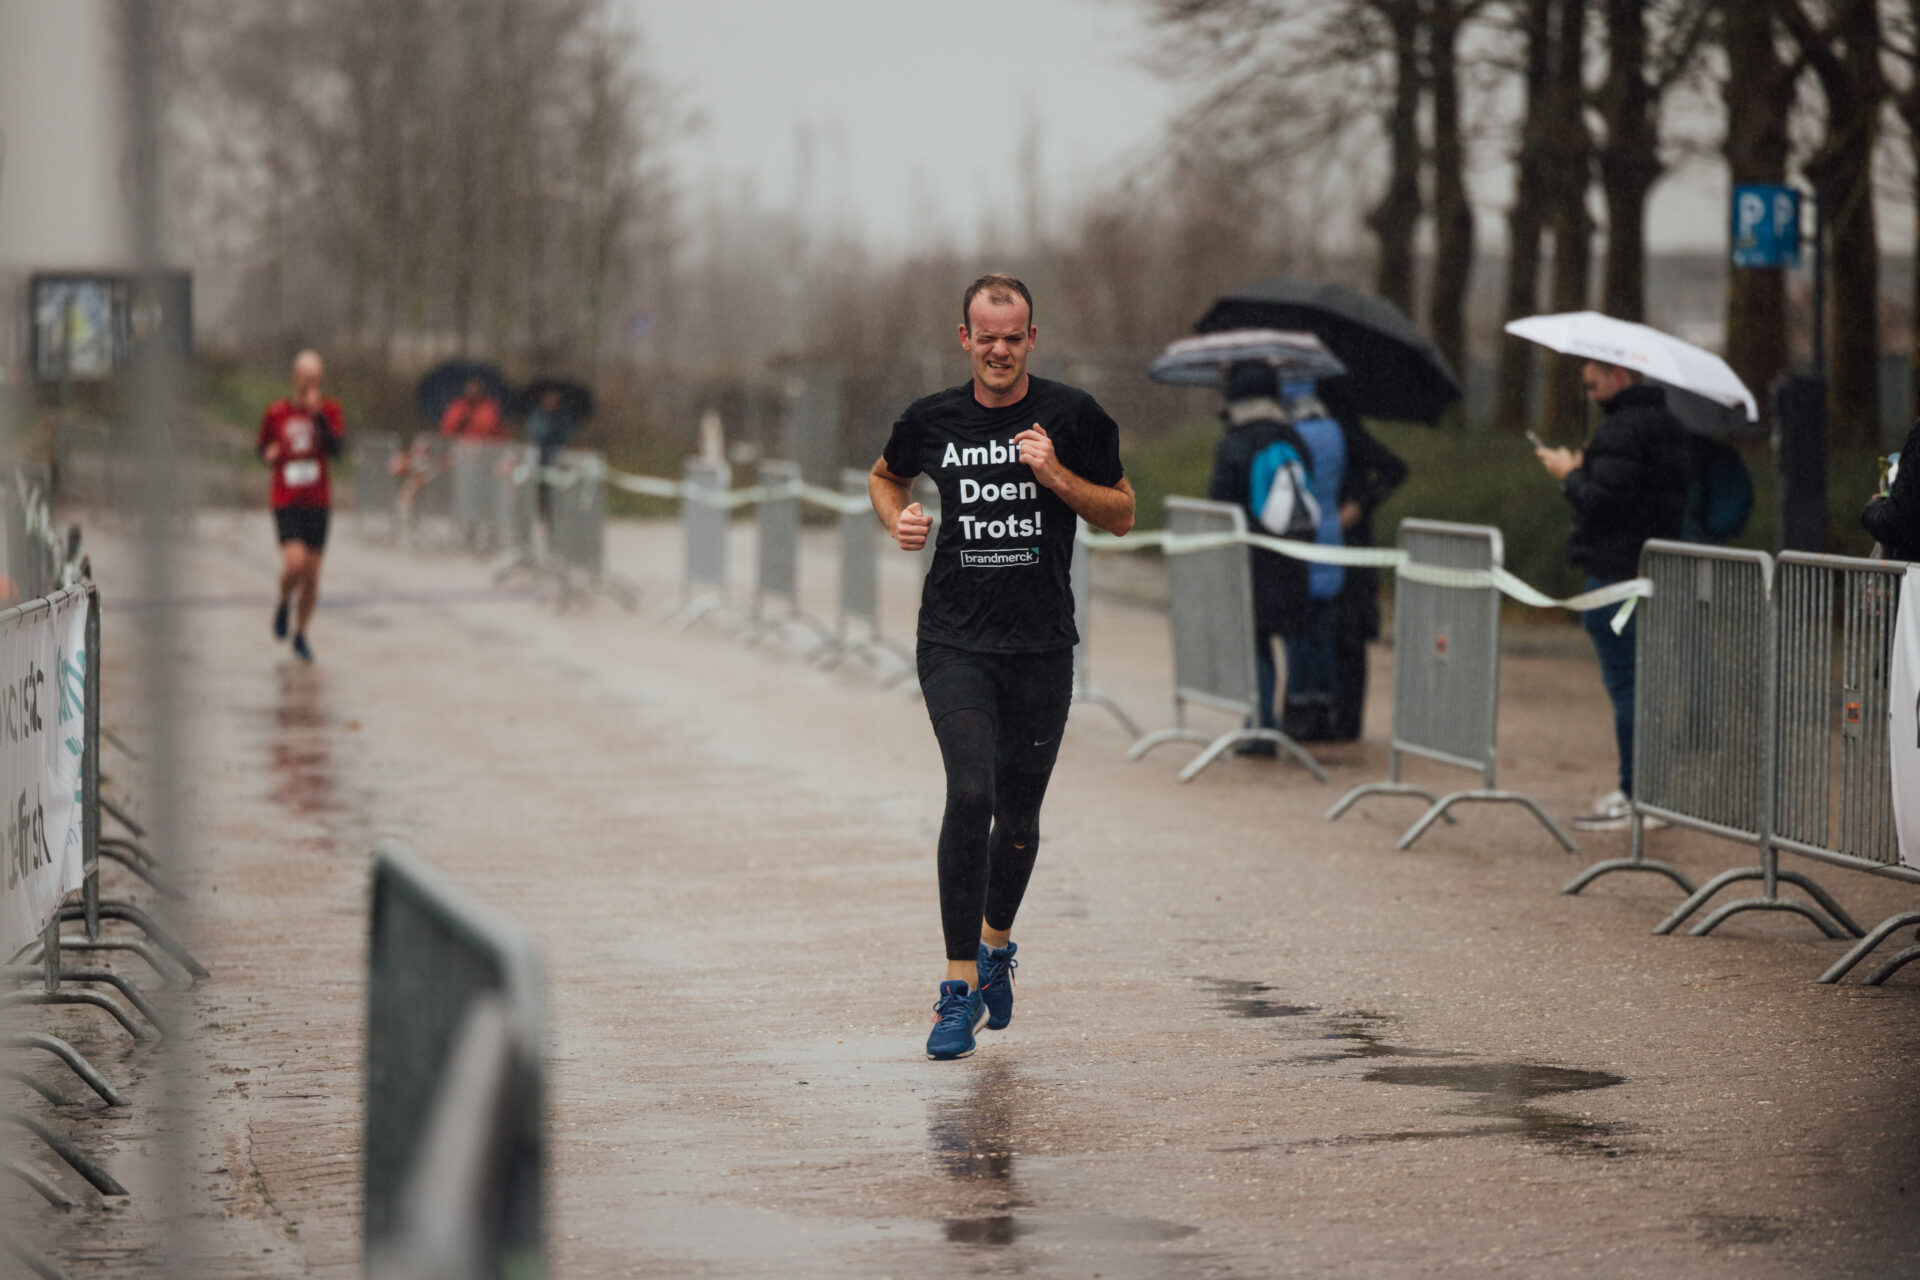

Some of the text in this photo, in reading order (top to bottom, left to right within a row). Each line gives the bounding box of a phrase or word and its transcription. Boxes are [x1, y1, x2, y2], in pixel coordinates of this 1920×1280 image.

[1739, 192, 1765, 238] P
[959, 478, 1037, 504] Doen
[958, 511, 1042, 540] Trots!
[964, 551, 1033, 564] brandmerck
